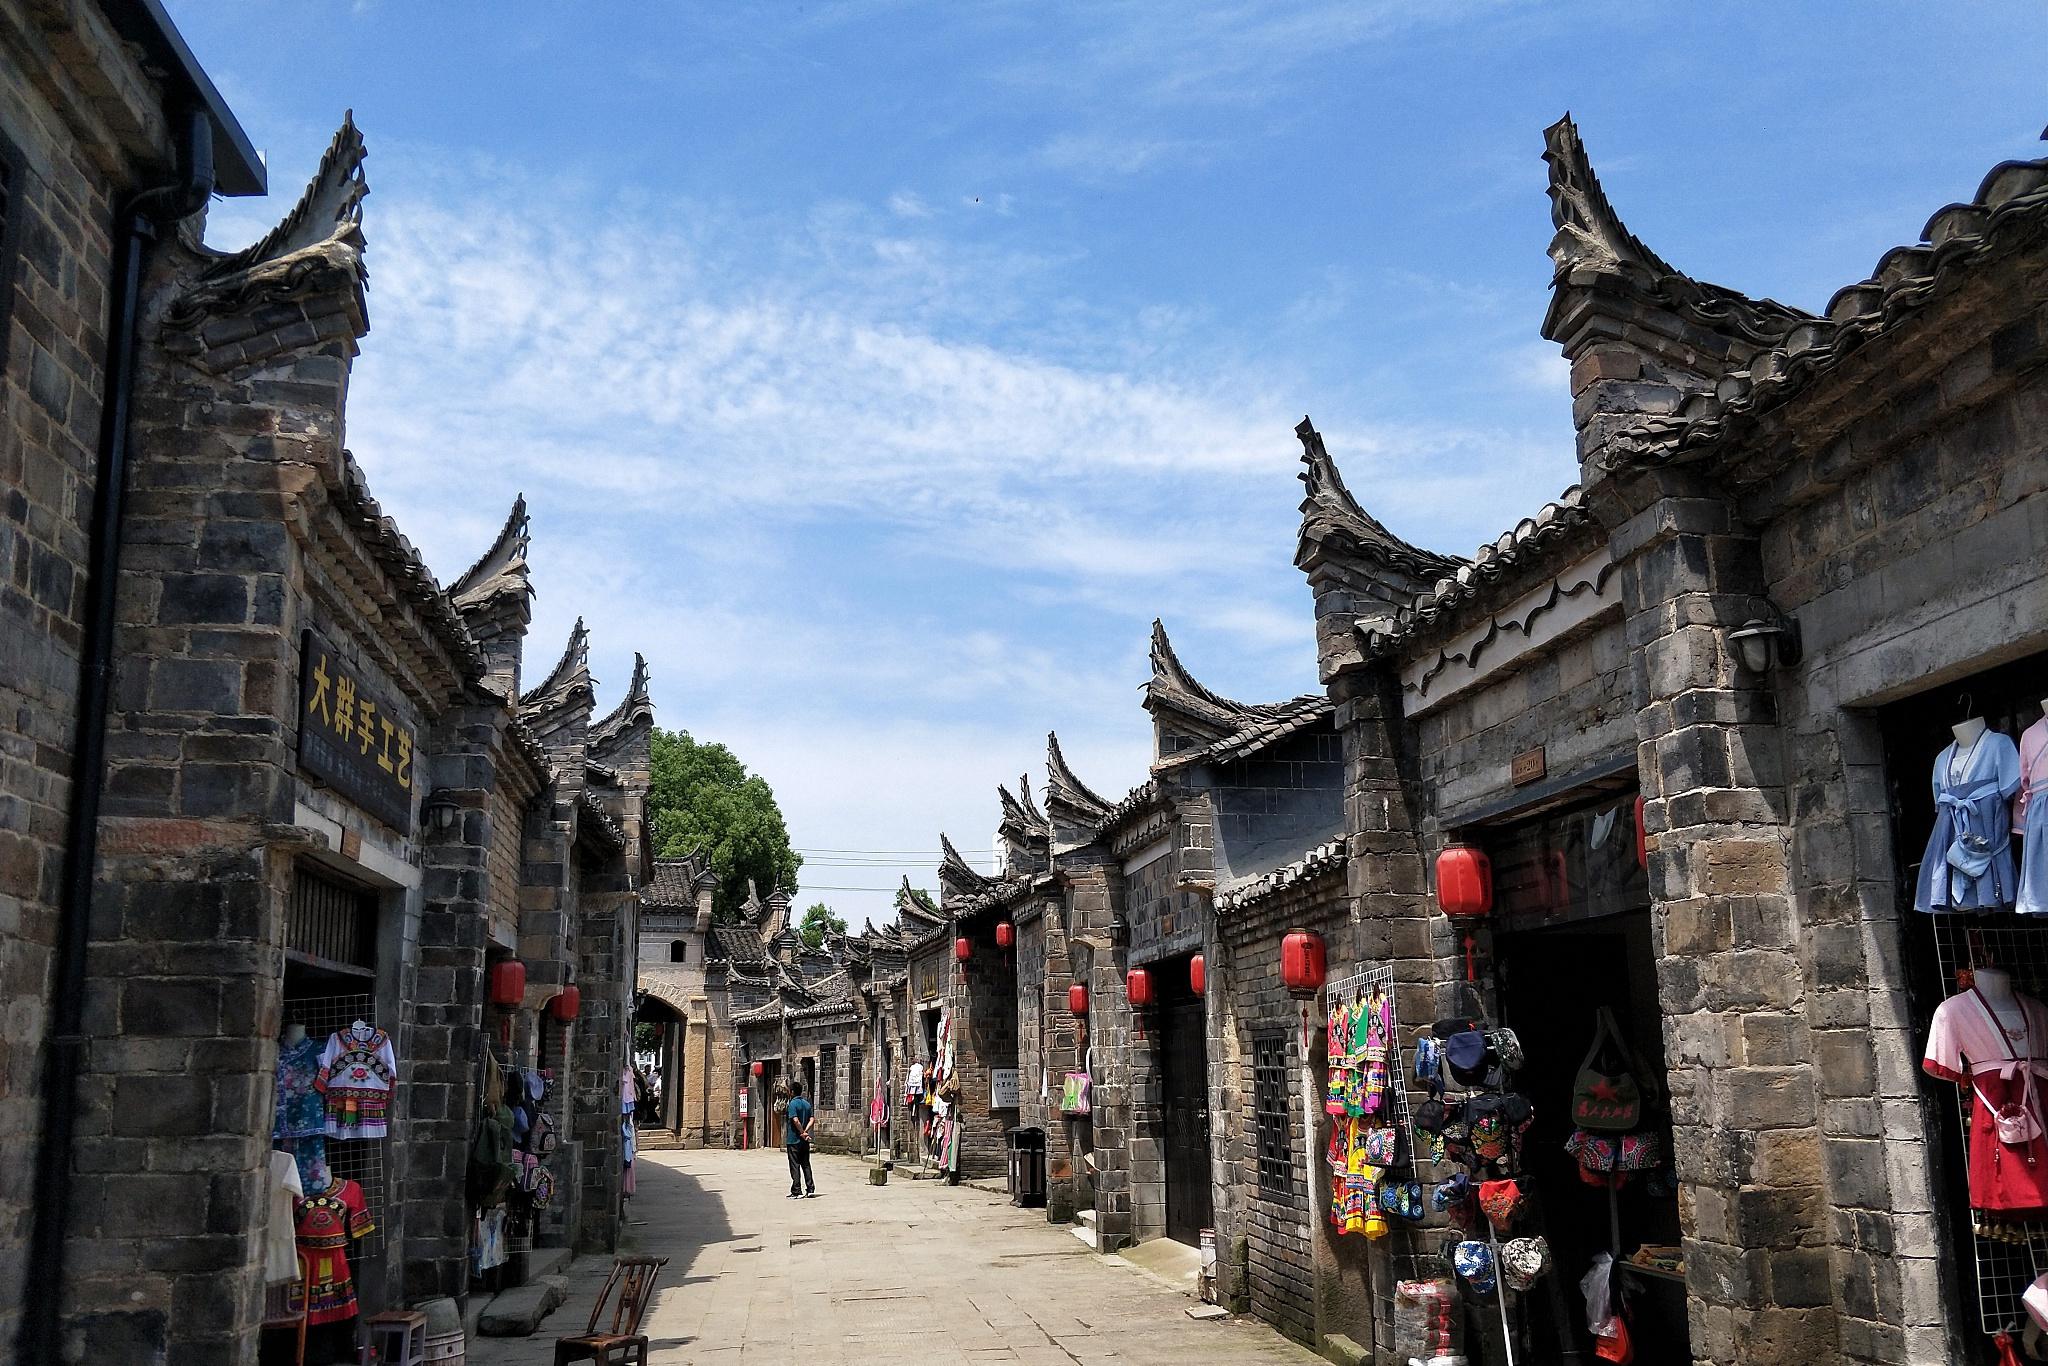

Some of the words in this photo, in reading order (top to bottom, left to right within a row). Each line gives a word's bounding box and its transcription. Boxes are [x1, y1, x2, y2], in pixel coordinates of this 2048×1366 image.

[309, 654, 412, 788] 大群手工艺
